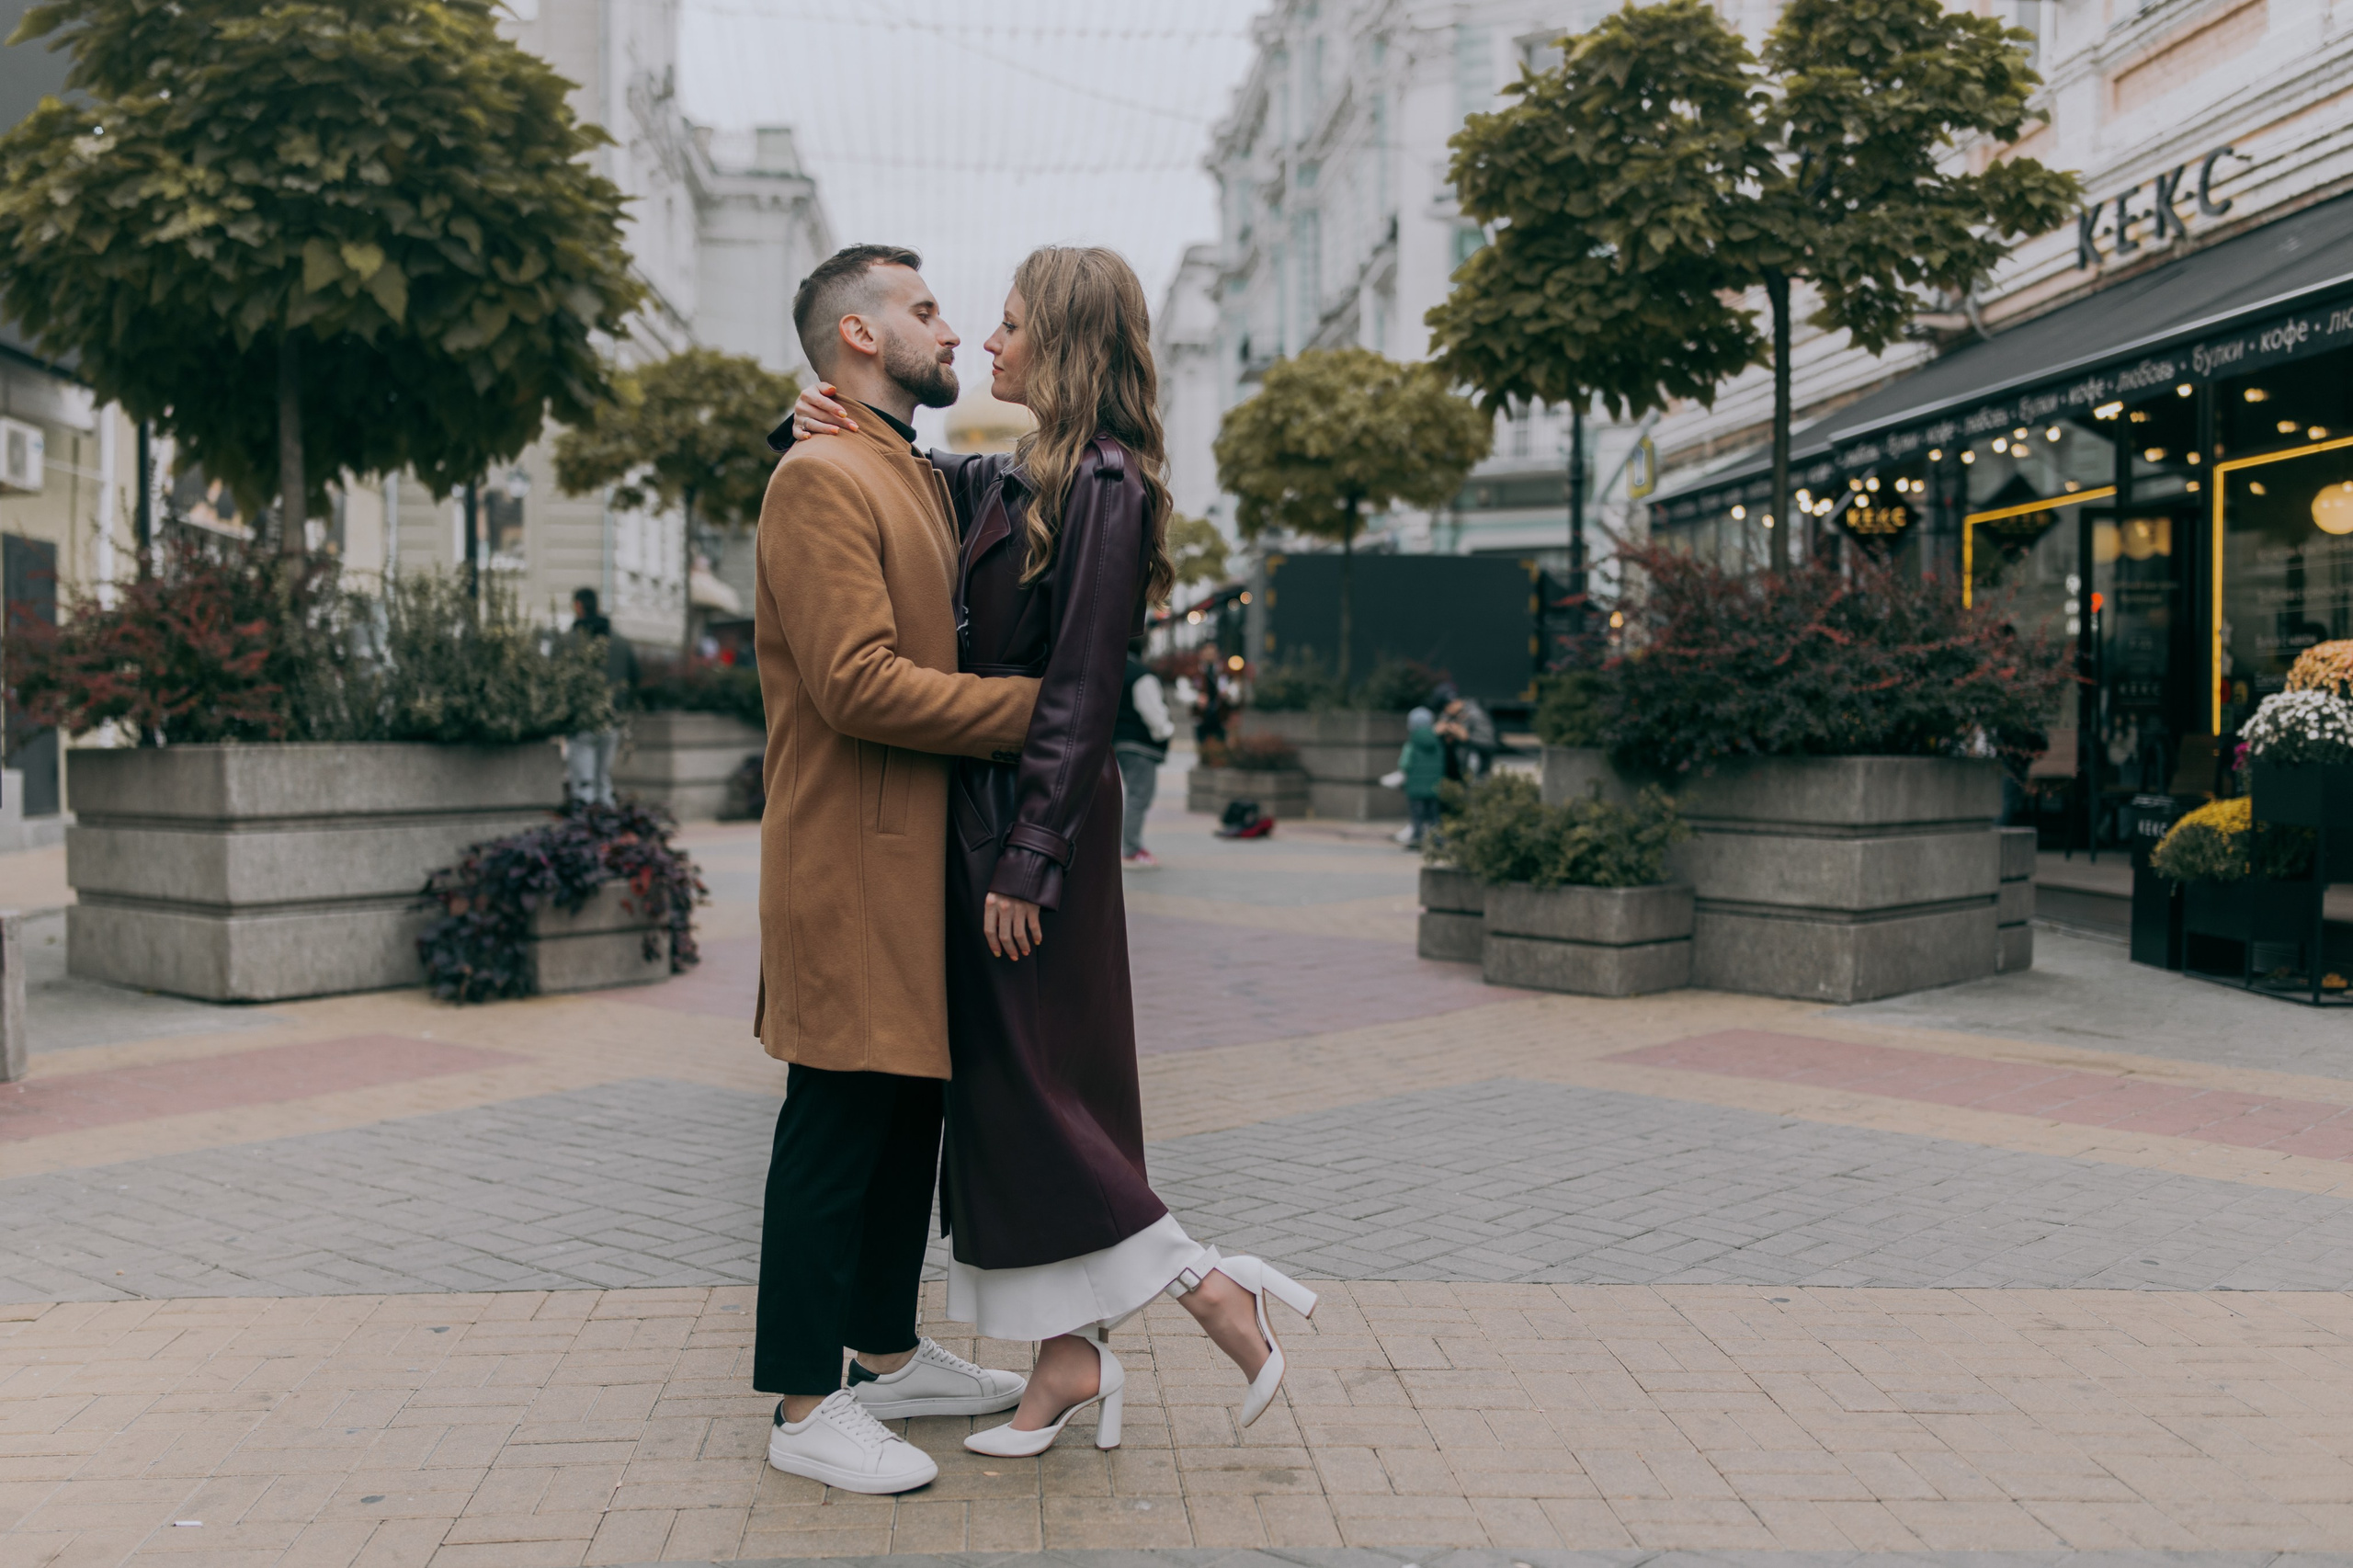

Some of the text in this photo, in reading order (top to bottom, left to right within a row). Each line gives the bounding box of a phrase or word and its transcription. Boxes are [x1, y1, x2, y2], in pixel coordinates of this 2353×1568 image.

[2116, 359, 2176, 392] любовь
[2192, 343, 2244, 377] булки
[2260, 317, 2309, 353] кофе
